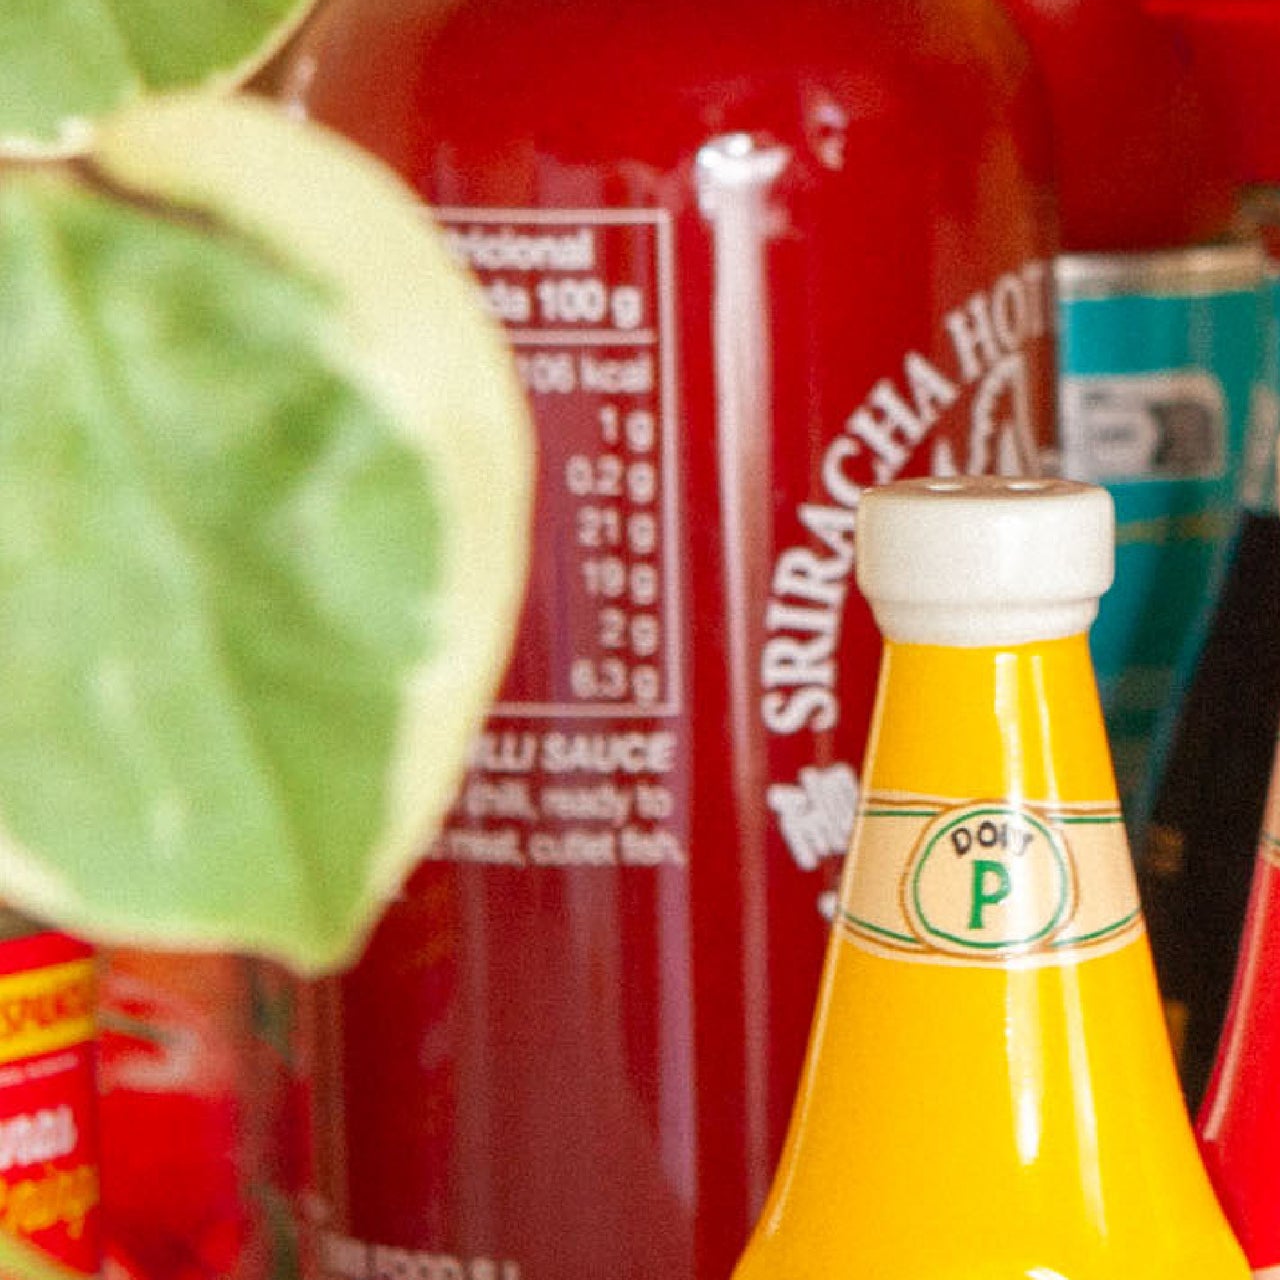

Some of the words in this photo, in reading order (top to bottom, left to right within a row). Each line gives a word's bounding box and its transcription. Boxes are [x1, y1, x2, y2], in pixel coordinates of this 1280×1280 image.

[536, 277, 605, 322] 100
[611, 285, 643, 330] g
[579, 352, 652, 394] kcal
[600, 403, 618, 445] 1
[625, 409, 655, 453] g
[627, 462, 655, 505] g
[627, 512, 656, 555] g
[762, 352, 960, 736] SRIRACHA
[629, 563, 658, 606] g
[630, 614, 659, 657] g
[631, 664, 659, 708] g
[541, 731, 678, 774] SAUCE
[951, 820, 1034, 858] DOIY
[969, 859, 1013, 930] P
